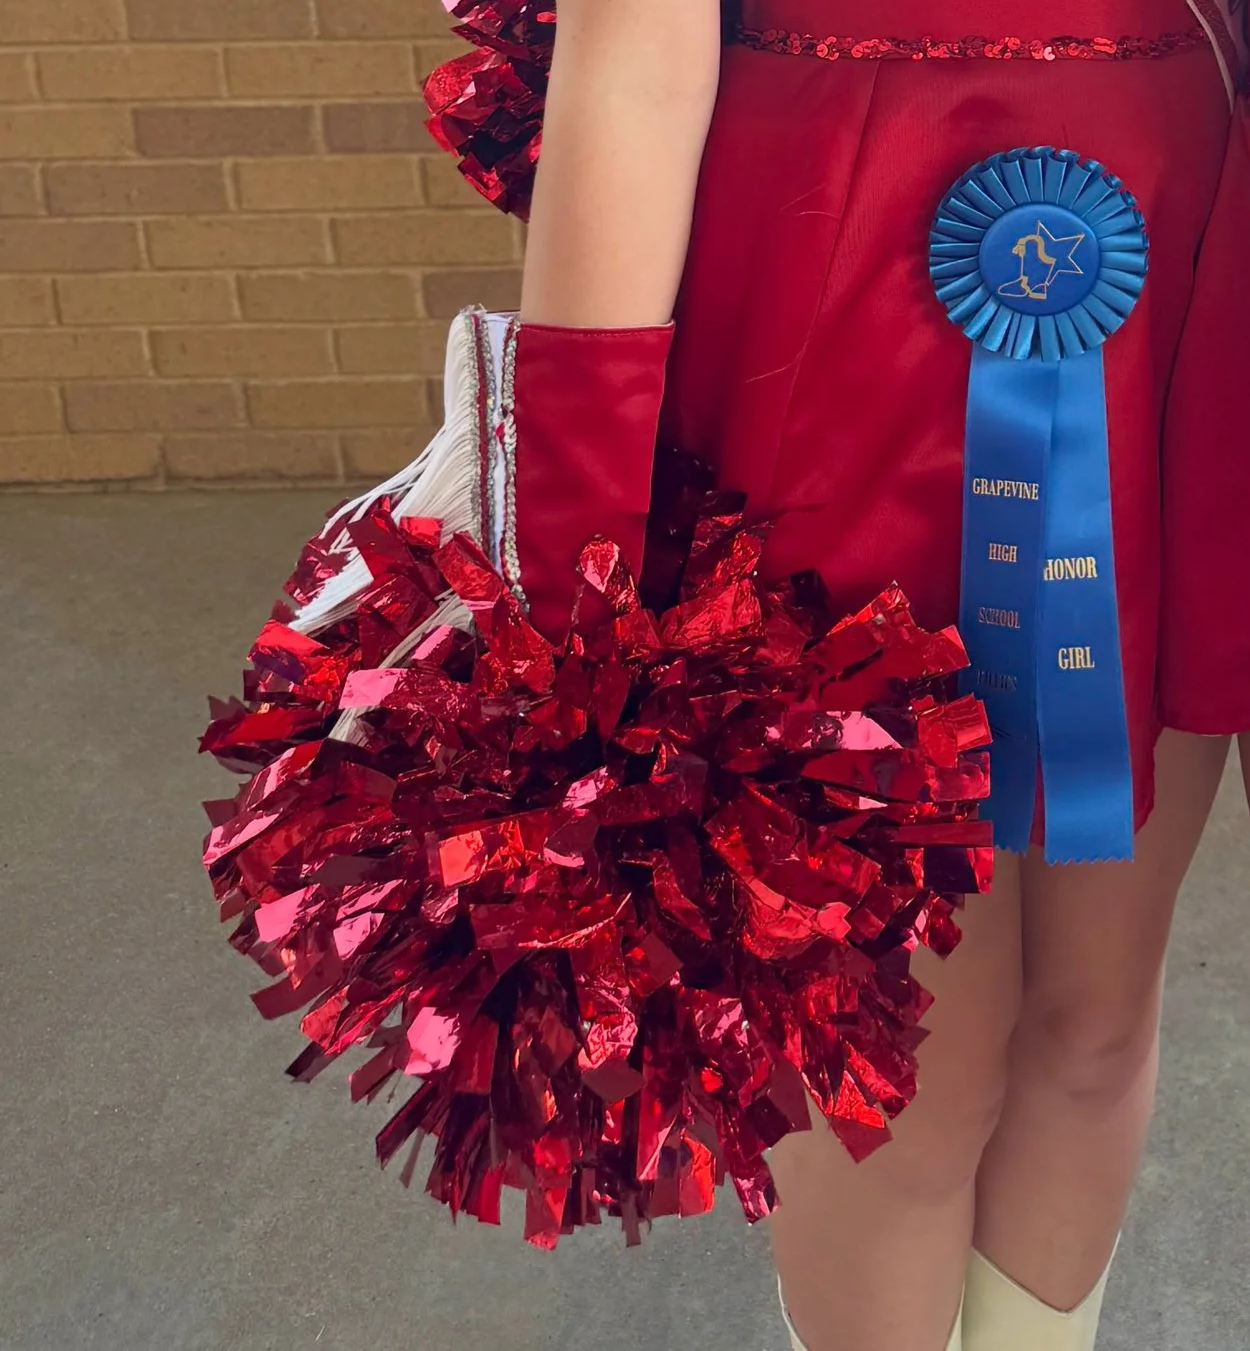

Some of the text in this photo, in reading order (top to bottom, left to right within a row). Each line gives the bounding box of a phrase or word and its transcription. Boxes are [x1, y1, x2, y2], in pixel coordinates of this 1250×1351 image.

[973, 478, 1039, 500] GRAPEVINE
[988, 543, 1017, 562] HIGH
[978, 607, 1020, 628] SCHOOL
[1058, 646, 1095, 669] GIRL
